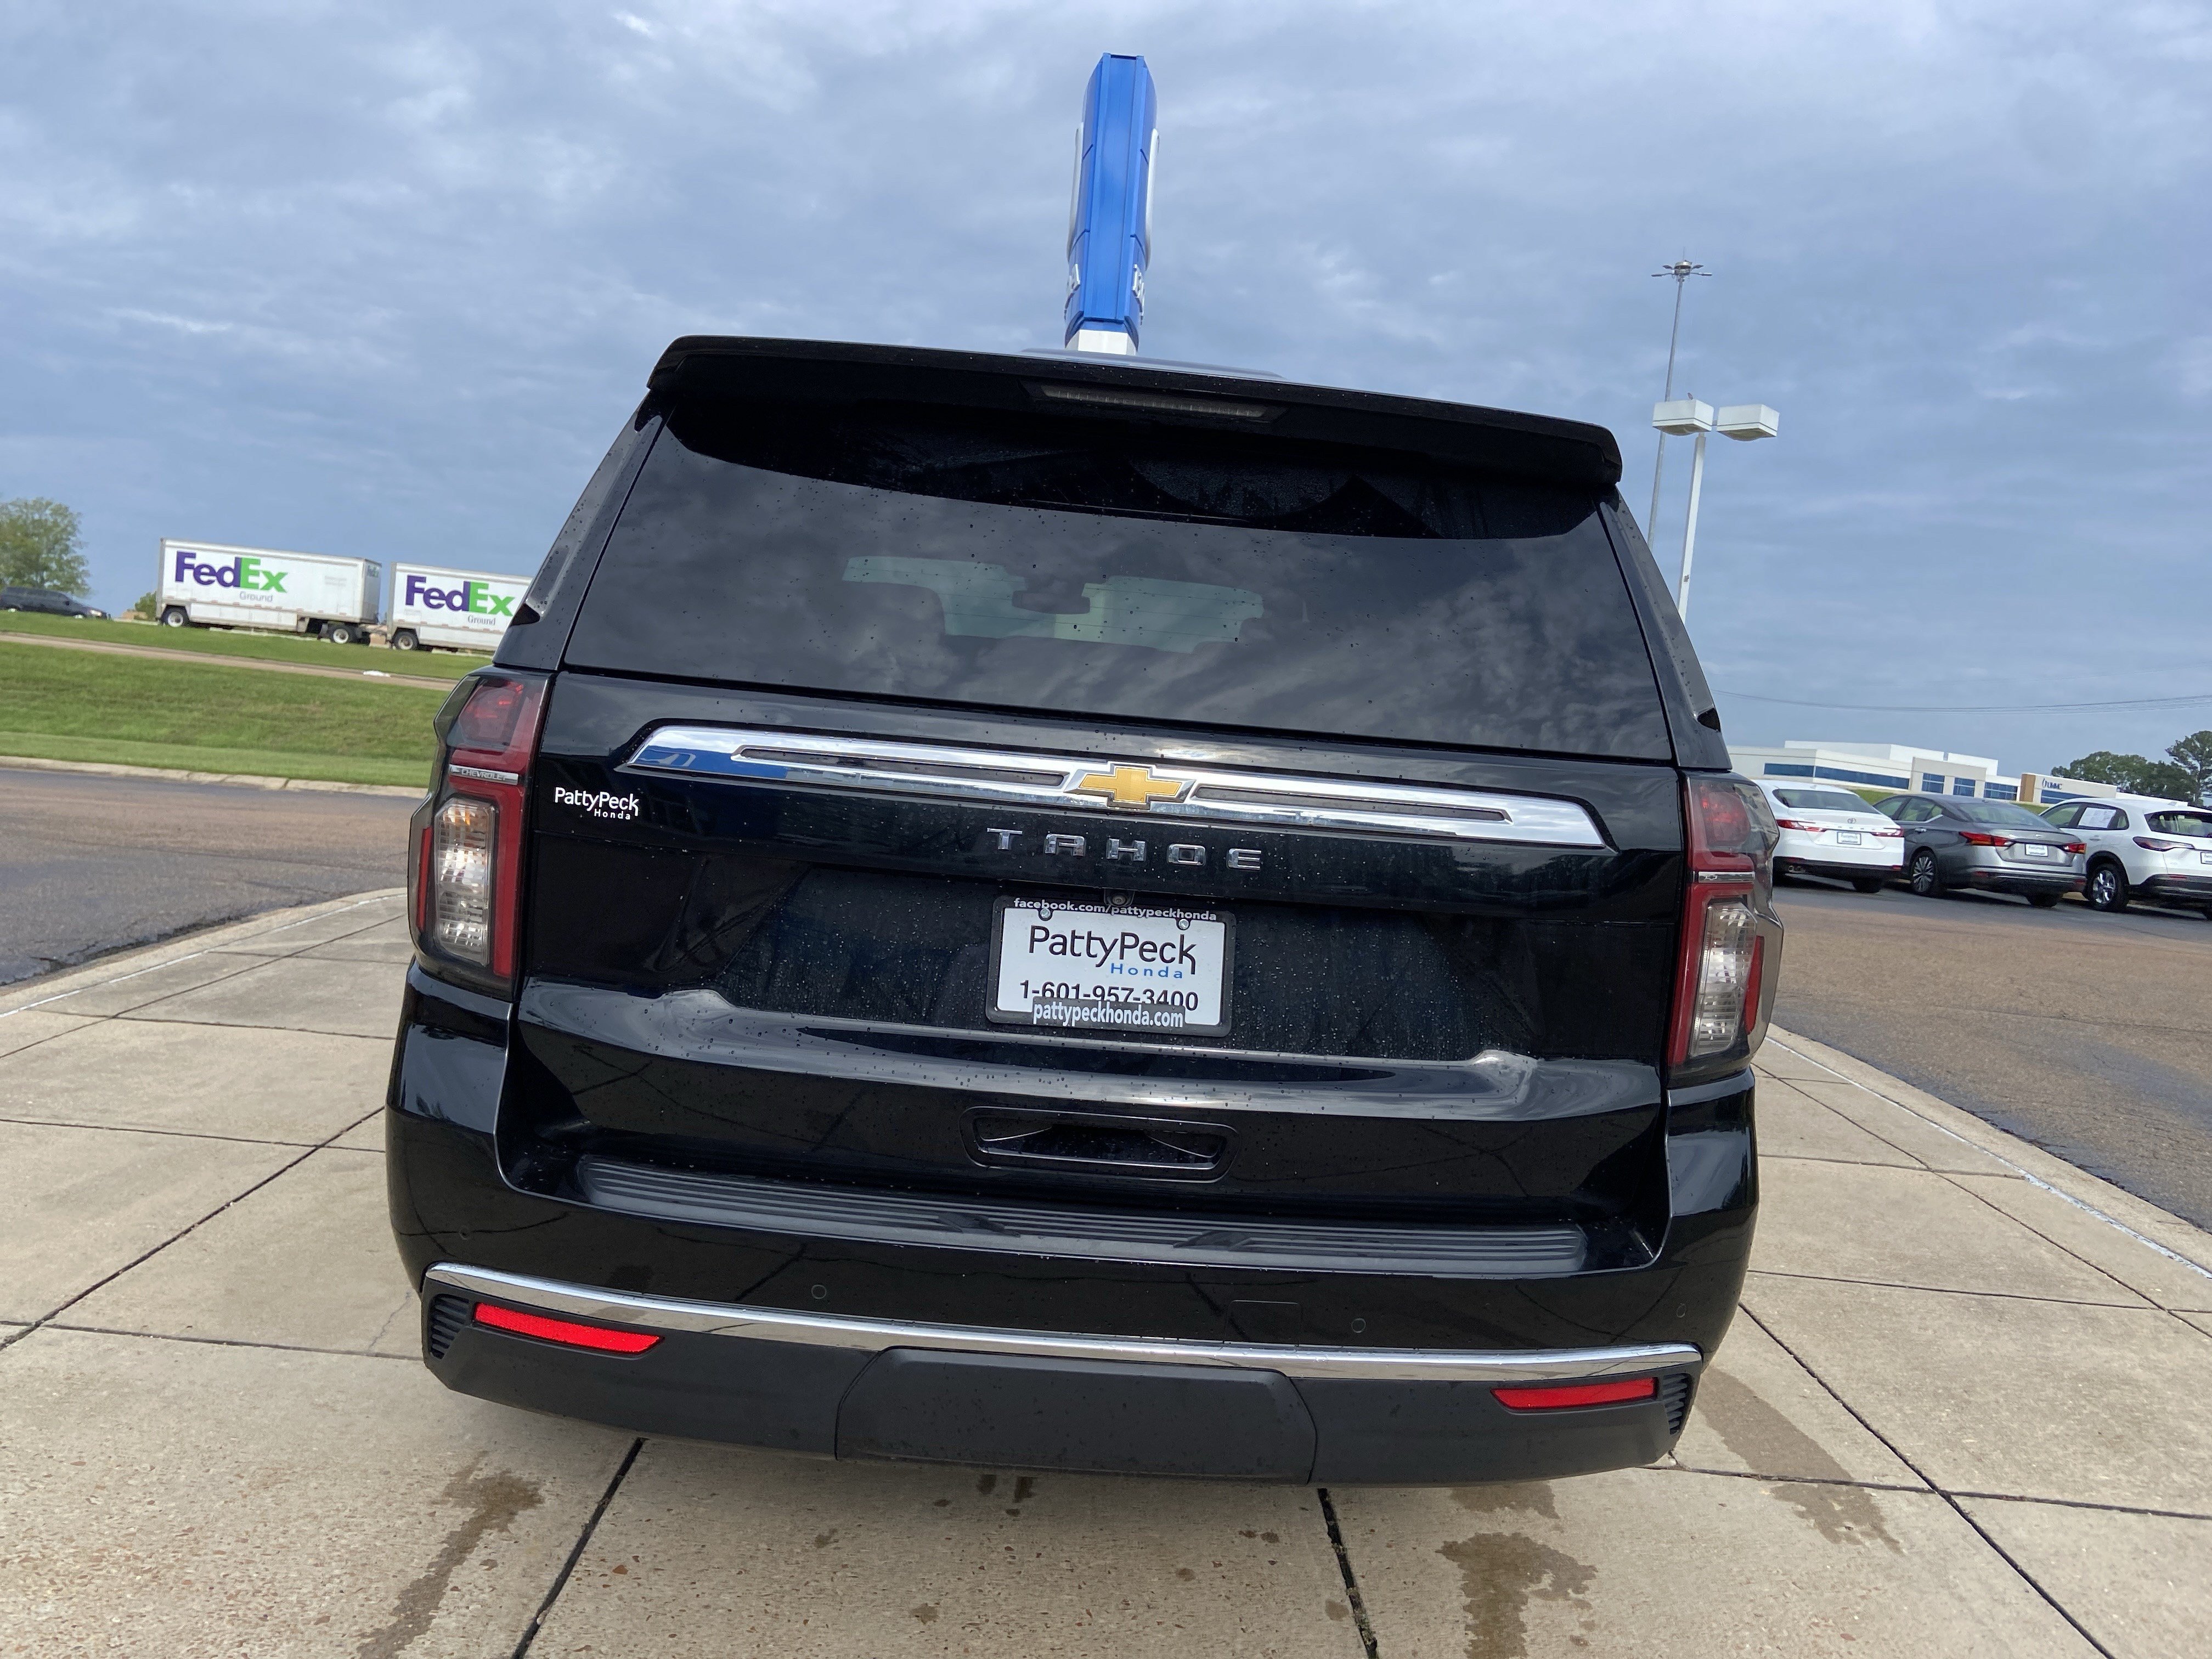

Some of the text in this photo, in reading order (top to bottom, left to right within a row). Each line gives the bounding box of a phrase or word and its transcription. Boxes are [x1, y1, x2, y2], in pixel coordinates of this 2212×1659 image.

[175, 551, 288, 593] FedEx
[239, 591, 273, 602] Ground
[405, 574, 515, 617] FedEx
[467, 614, 495, 625] Ground
[461, 768, 507, 781] CHEVROLET
[555, 787, 639, 816] PattyPeck
[594, 809, 630, 820] Honda
[987, 827, 1261, 870] TAHOE
[1014, 898, 1216, 921] facebook.com/pattypeckhonda
[1029, 925, 1197, 975] PattyPeck
[1110, 963, 1183, 979] Honda
[1020, 980, 1198, 1011] 1-601-957-3400
[1033, 1001, 1183, 1028] pattypeckhonda.com
